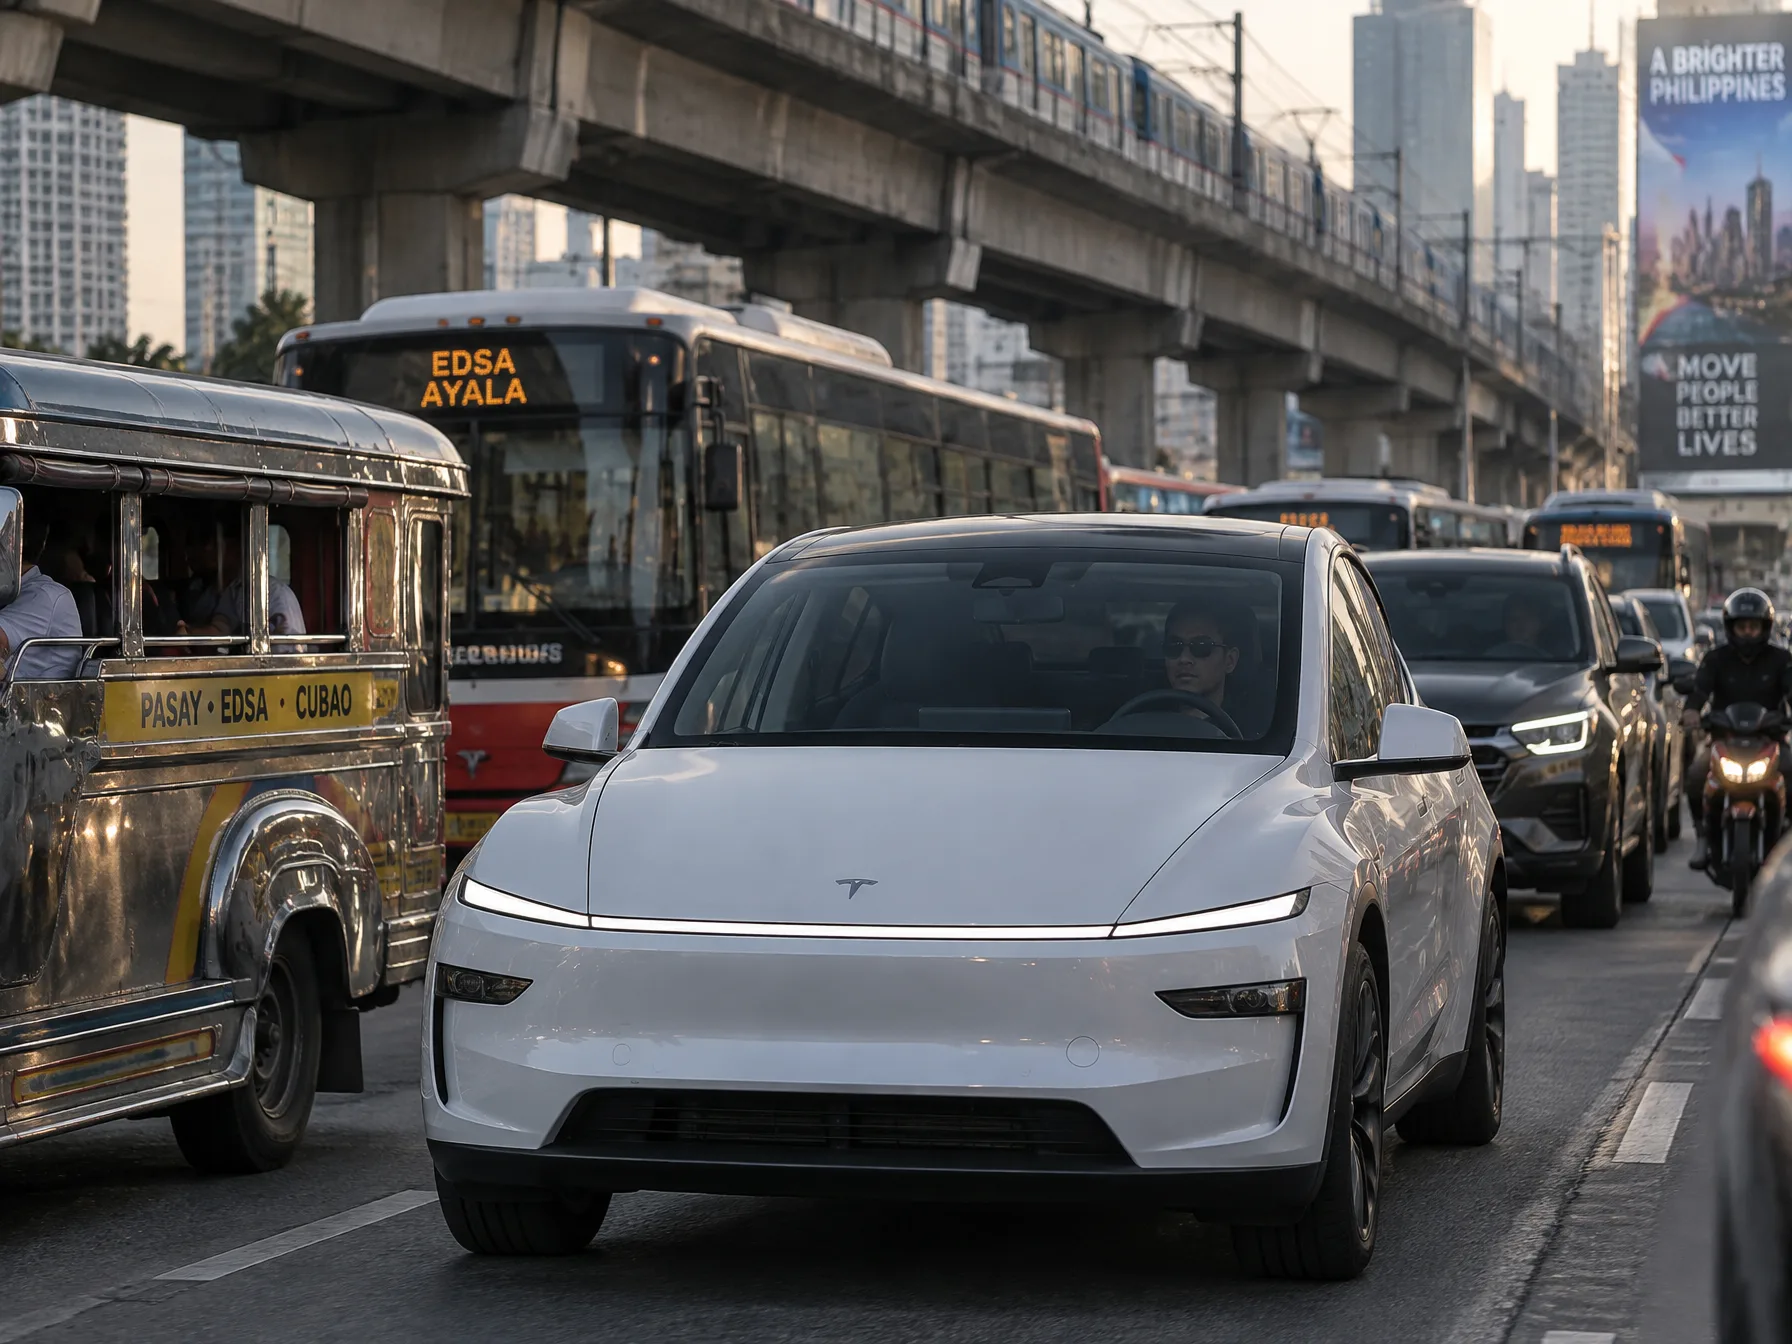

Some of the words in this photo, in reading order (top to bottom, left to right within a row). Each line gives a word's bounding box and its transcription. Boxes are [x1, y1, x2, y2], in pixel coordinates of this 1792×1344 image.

[1649, 46, 1668, 75] A
[1672, 42, 1785, 74] BRIGHTER
[1650, 72, 1786, 105] PHILIPPINES
[432, 348, 516, 377] EDSA
[1677, 352, 1757, 379] MOVE
[420, 378, 527, 408] AYALA
[1676, 380, 1758, 404] PEOPLE
[1678, 429, 1757, 456] LIVES
[141, 690, 202, 728] PASAY
[221, 688, 268, 724] EDSA
[296, 683, 351, 719] CUBAO
